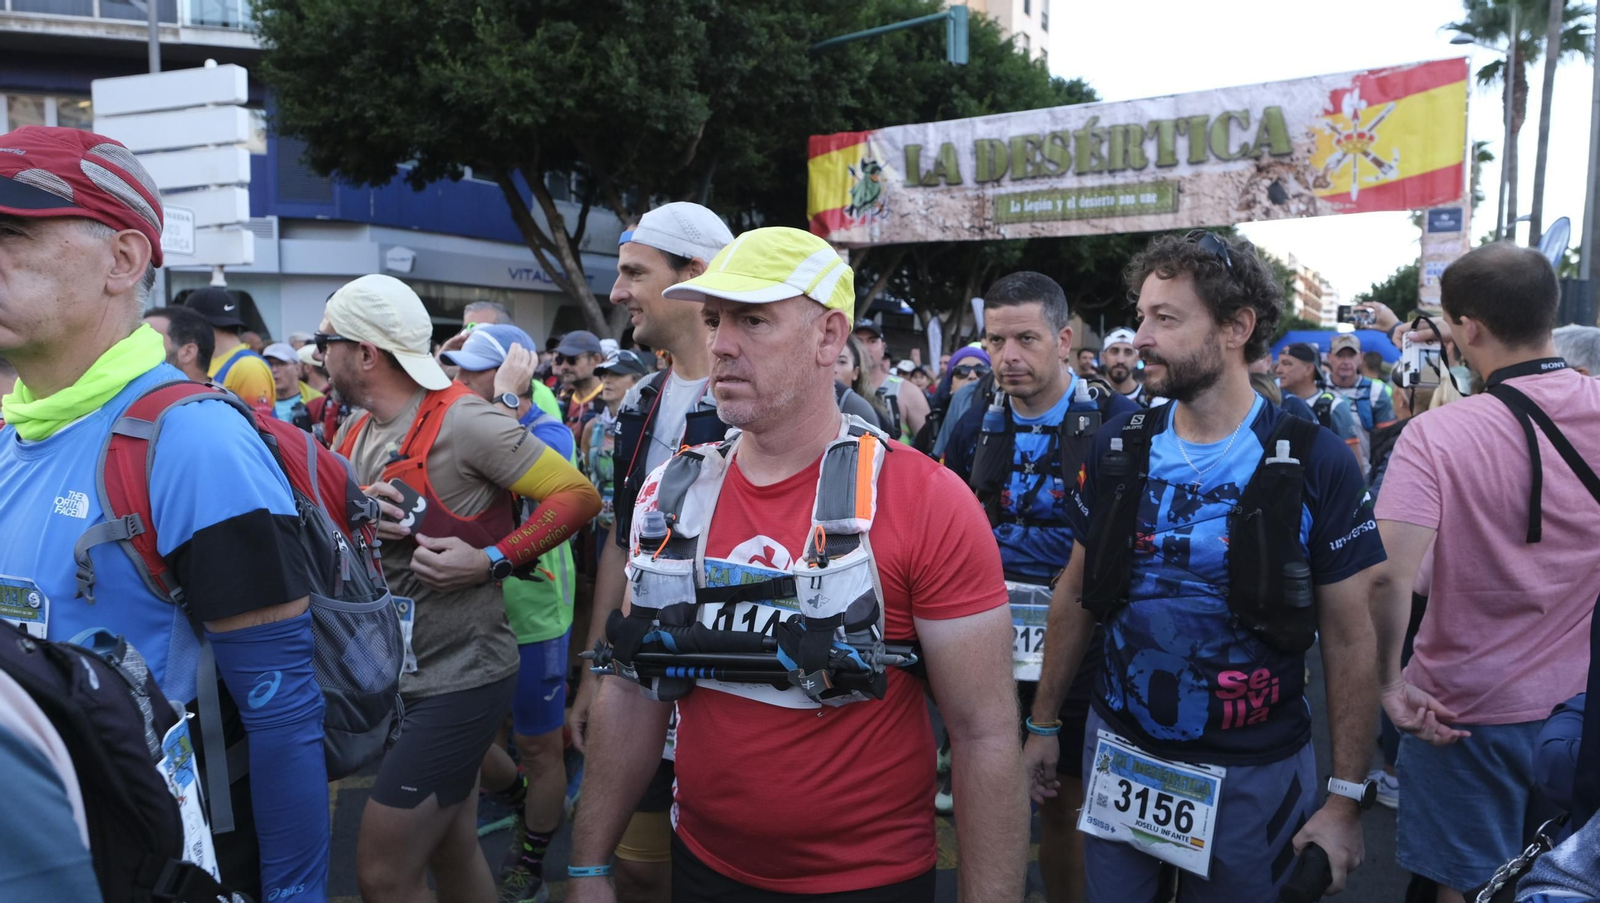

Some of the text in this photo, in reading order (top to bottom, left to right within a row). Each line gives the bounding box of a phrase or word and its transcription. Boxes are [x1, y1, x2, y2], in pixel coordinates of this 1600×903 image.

[904, 105, 1294, 187] LA DESÉRTICA
[1010, 193, 1157, 213] La Legión y el desierto nos une
[1541, 362, 1565, 370] SONY
[55, 497, 79, 510] ORTH
[68, 490, 83, 500] THE
[54, 505, 77, 518] FACE
[508, 534, 523, 546] 101
[537, 508, 557, 527] 24H
[516, 524, 569, 560] La Legión
[710, 566, 730, 585] LA
[1114, 779, 1196, 834] 3156
[1087, 815, 1110, 831] asisa
[1135, 819, 1190, 844] JOSELU INFANTE
